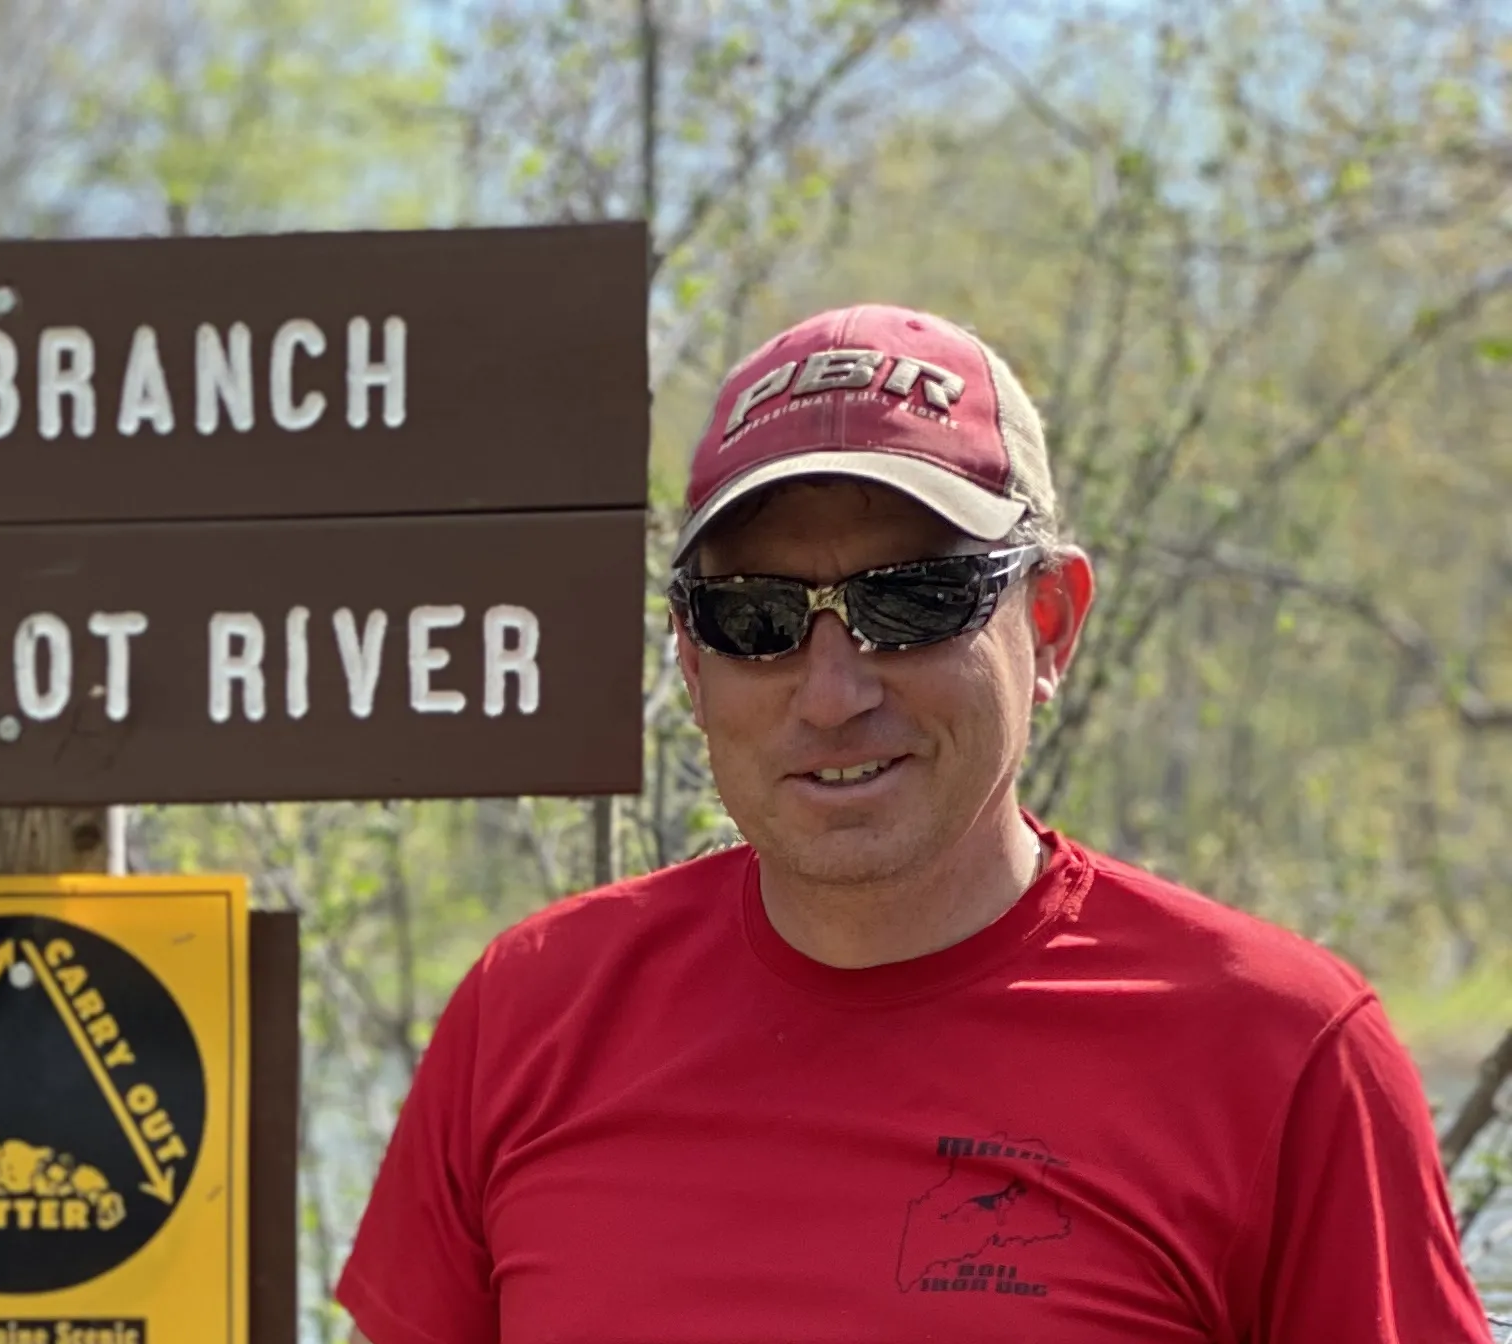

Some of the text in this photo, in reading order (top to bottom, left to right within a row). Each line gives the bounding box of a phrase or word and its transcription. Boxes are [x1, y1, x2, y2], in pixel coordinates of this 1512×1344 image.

[723, 349, 966, 441] PBR
[207, 603, 542, 722] RIVER
[43, 937, 188, 1165] CARRY OUT
